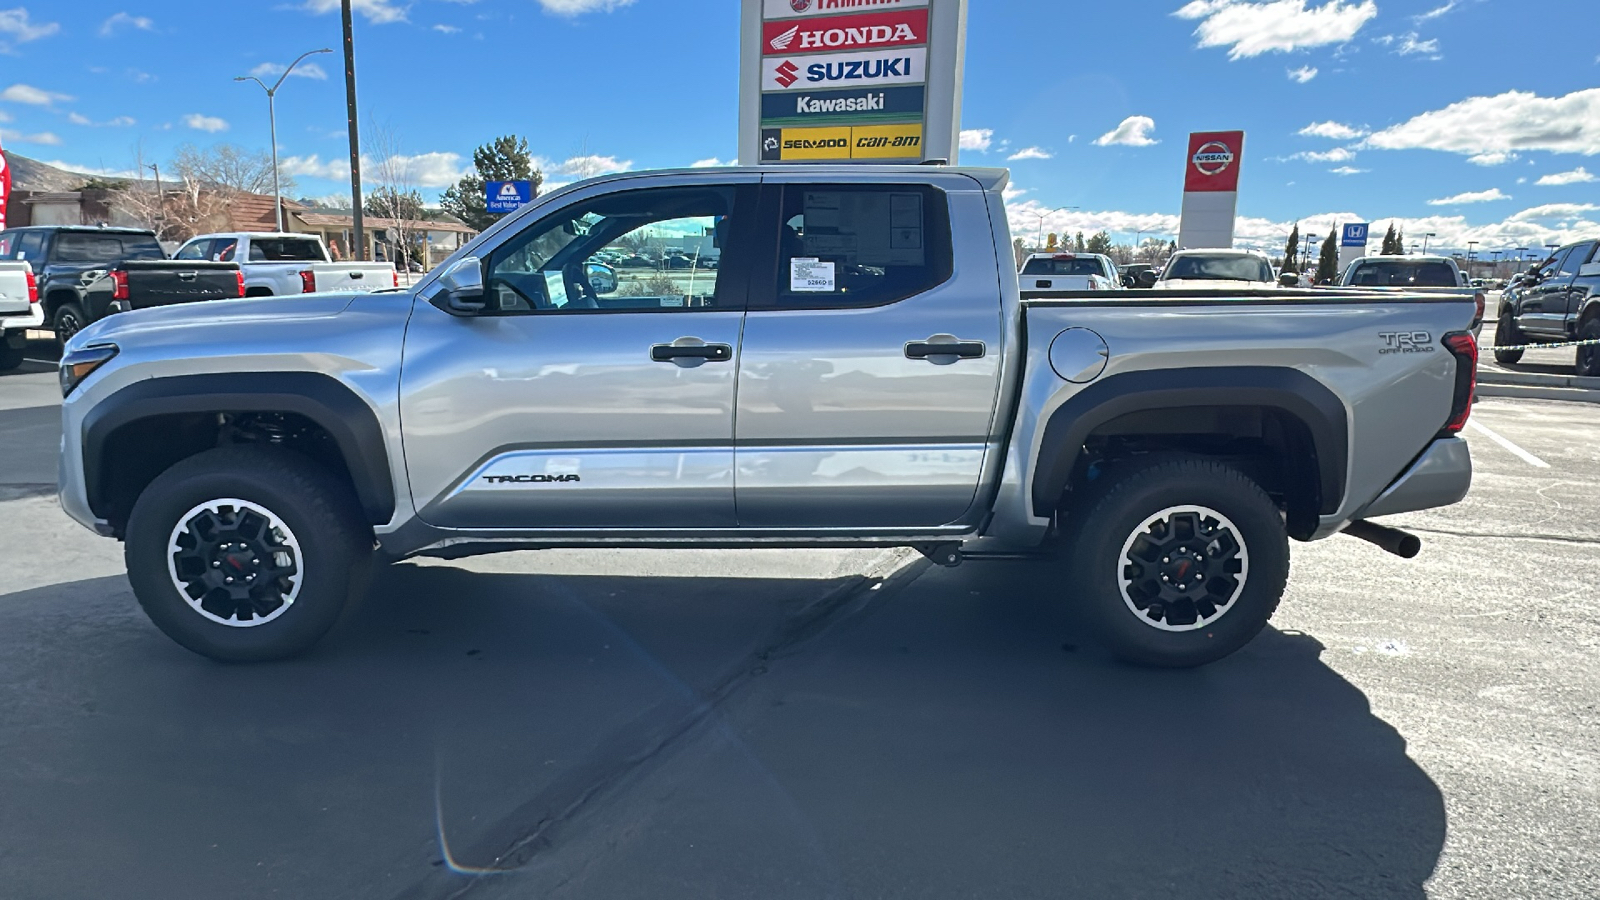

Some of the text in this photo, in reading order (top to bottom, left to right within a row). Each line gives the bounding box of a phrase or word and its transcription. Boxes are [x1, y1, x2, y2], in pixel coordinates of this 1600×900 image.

[800, 23, 917, 48] HONDA
[807, 58, 911, 82] SUZUKI
[797, 93, 884, 113] Kawasaki
[1378, 331, 1432, 348] TRD
[482, 474, 581, 483] TACOMA
